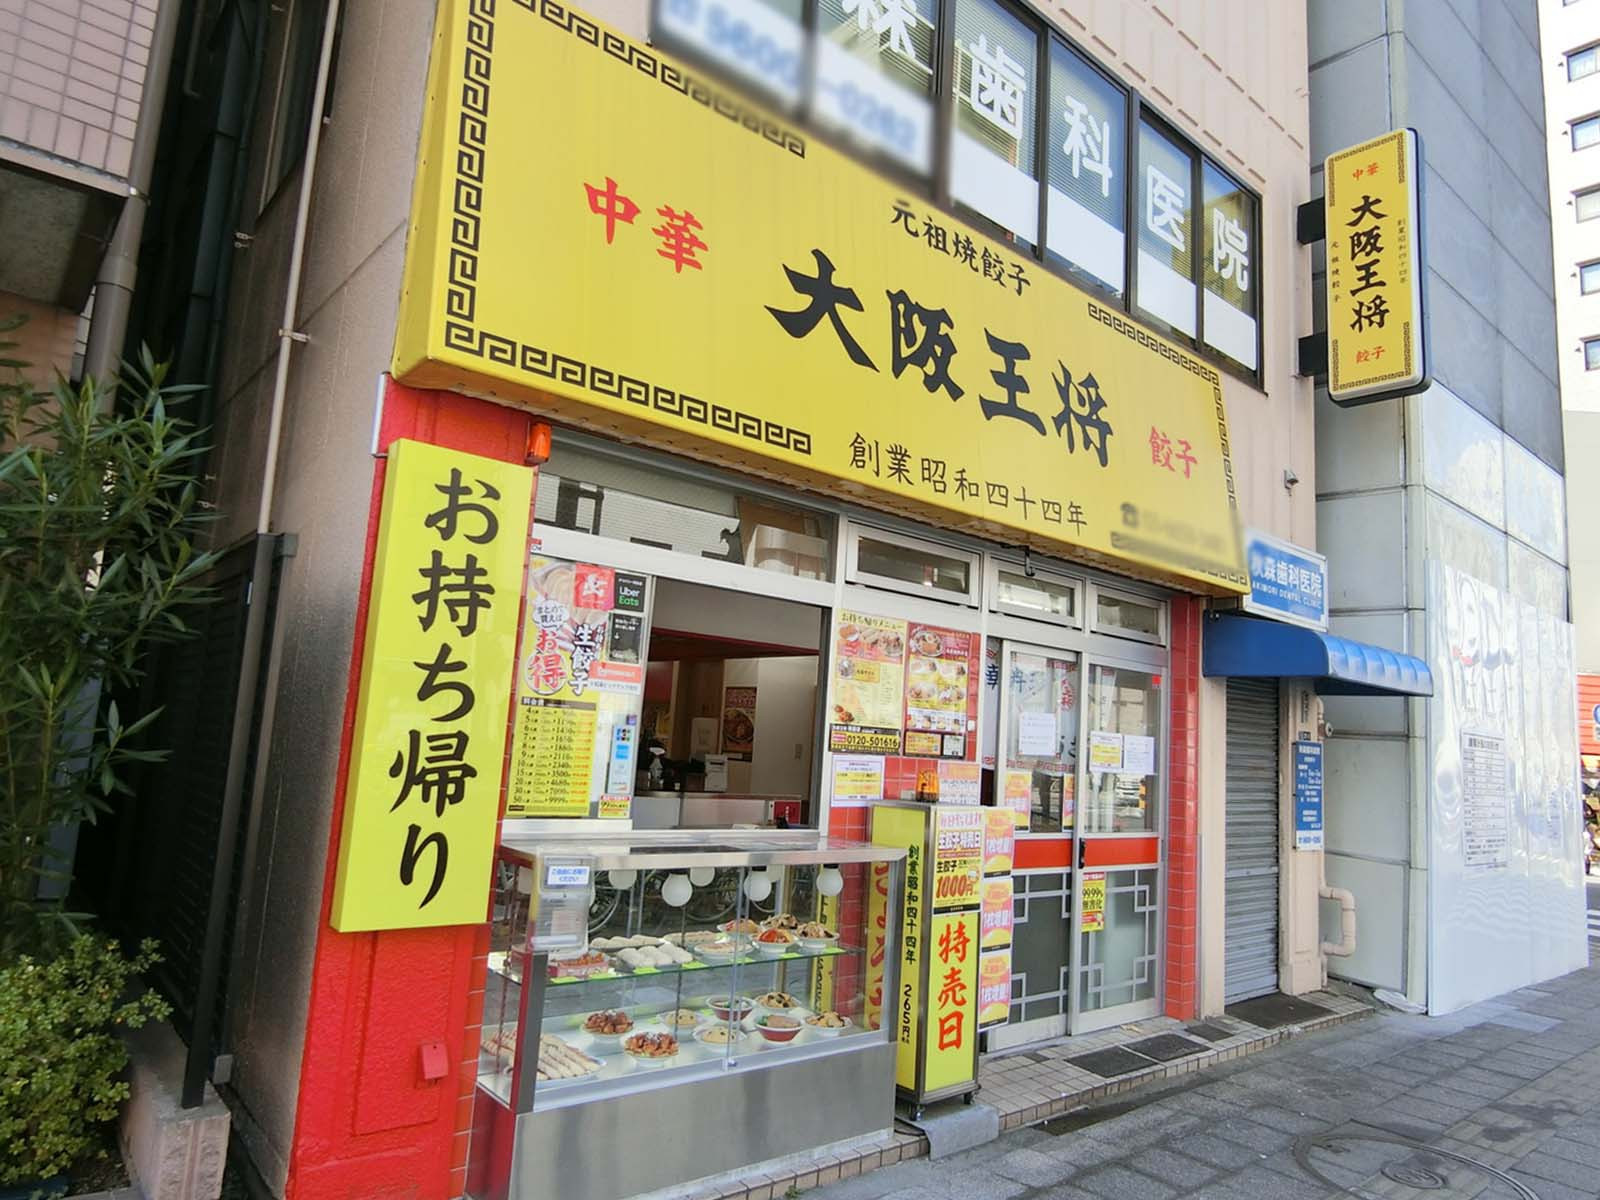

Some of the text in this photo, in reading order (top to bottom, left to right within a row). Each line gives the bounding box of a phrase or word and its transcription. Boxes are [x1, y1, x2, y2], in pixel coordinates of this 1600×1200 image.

[1352, 163, 1379, 181] 中華
[583, 177, 708, 273] 中華
[891, 201, 1031, 297] 元祖焼餃子
[1345, 195, 1390, 333] 大阪王将
[764, 249, 1114, 468] 大阪王将
[1355, 346, 1385, 364] 餃子
[849, 432, 1088, 536] 創業昭和四十四年
[1149, 426, 1198, 480] 餃子
[619, 586, 640, 597] Uber
[619, 596, 640, 606] Eats
[388, 467, 501, 910] お持ち帰り
[528, 628, 567, 689] お得
[568, 624, 596, 696] 生餃子
[846, 734, 898, 748] 0120-501616
[936, 860, 957, 873] 生餃子
[936, 874, 973, 899] 1000円
[904, 844, 920, 965] 創業昭和四十四年
[937, 921, 971, 1051] 特売日
